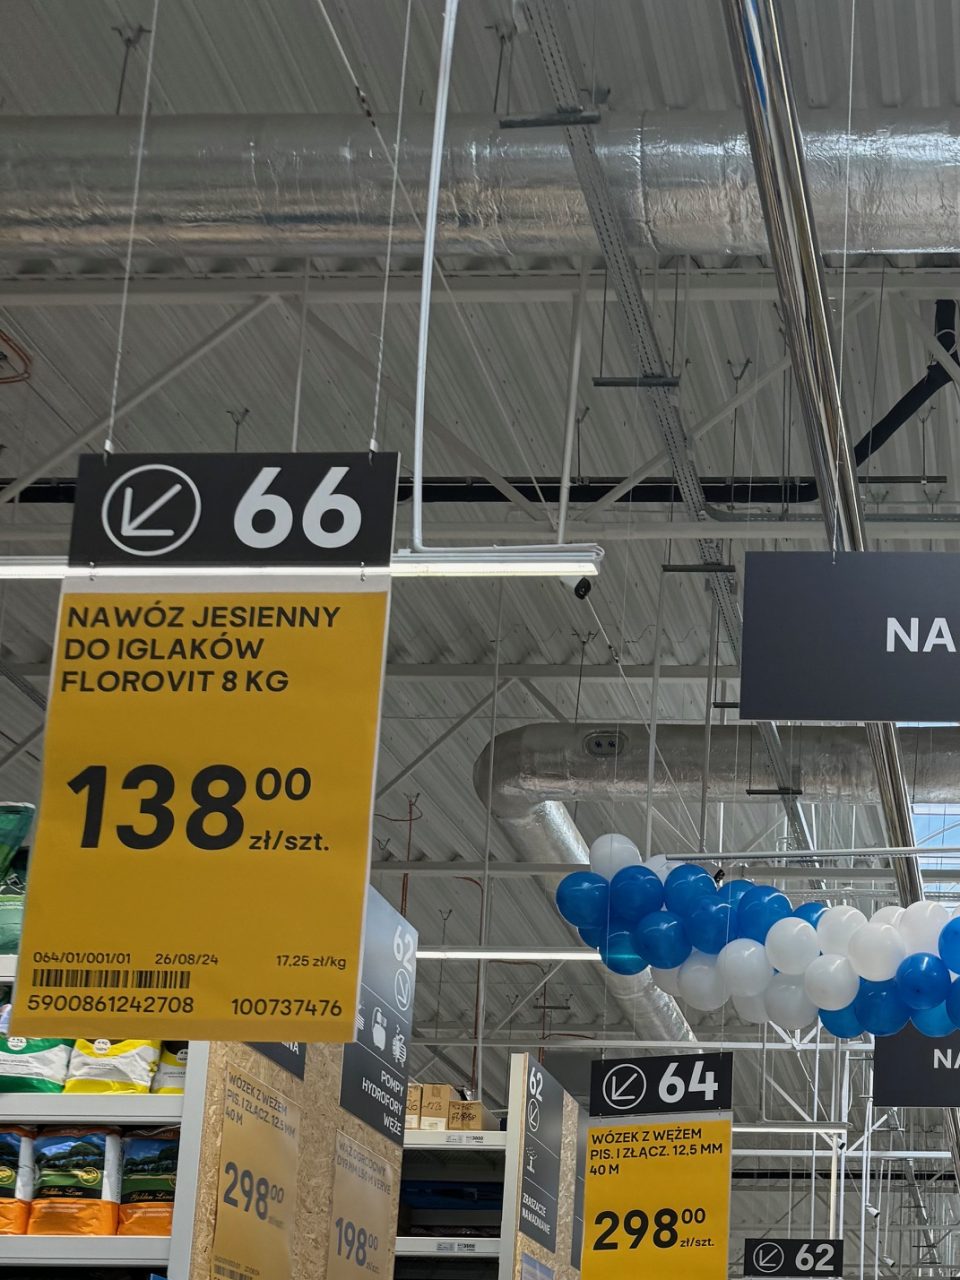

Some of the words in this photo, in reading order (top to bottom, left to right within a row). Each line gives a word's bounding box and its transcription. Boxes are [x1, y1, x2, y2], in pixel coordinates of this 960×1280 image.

[234, 467, 362, 549] 66
[67, 601, 184, 628] NAWÓZ
[193, 606, 341, 628] JESIENNY
[65, 639, 109, 660] DO
[117, 634, 264, 660] IGLAKÓW
[60, 671, 217, 692] FLOROVIT
[221, 671, 237, 692] 8
[247, 671, 289, 692] KG
[255, 768, 311, 800] 00
[67, 764, 247, 850] 138
[249, 830, 330, 851] zł/szt.
[33, 951, 131, 965] 064/01/001/01
[154, 953, 219, 966] 26/08/24
[312, 955, 346, 970] zł/kg
[393, 926, 413, 972] 62
[27, 995, 194, 1014] 5900861242708
[231, 999, 342, 1017] 100737476
[381, 1070, 403, 1097] POMPY
[529, 1067, 543, 1102] 62
[658, 1060, 719, 1103] 64
[362, 1077, 402, 1115] HYDROFORY
[384, 1112, 402, 1136] WĘŻE
[592, 1130, 639, 1145] WÓZEK
[642, 1131, 649, 1142] Z
[653, 1126, 702, 1143] WĘŻEM
[590, 1149, 614, 1160] PIS.
[616, 1148, 620, 1159] I
[623, 1146, 670, 1160] ZŁĄCZ.
[701, 1143, 723, 1154] MM
[590, 1165, 606, 1176] 40
[609, 1164, 619, 1175] M
[224, 1161, 270, 1221] 298
[271, 1184, 284, 1204] 00
[593, 1208, 680, 1250] 298
[682, 1208, 706, 1224] 00
[335, 1217, 367, 1267] 198
[368, 1233, 378, 1251] 00
[680, 1237, 715, 1249] zł/szt.
[795, 1245, 835, 1271] 62
